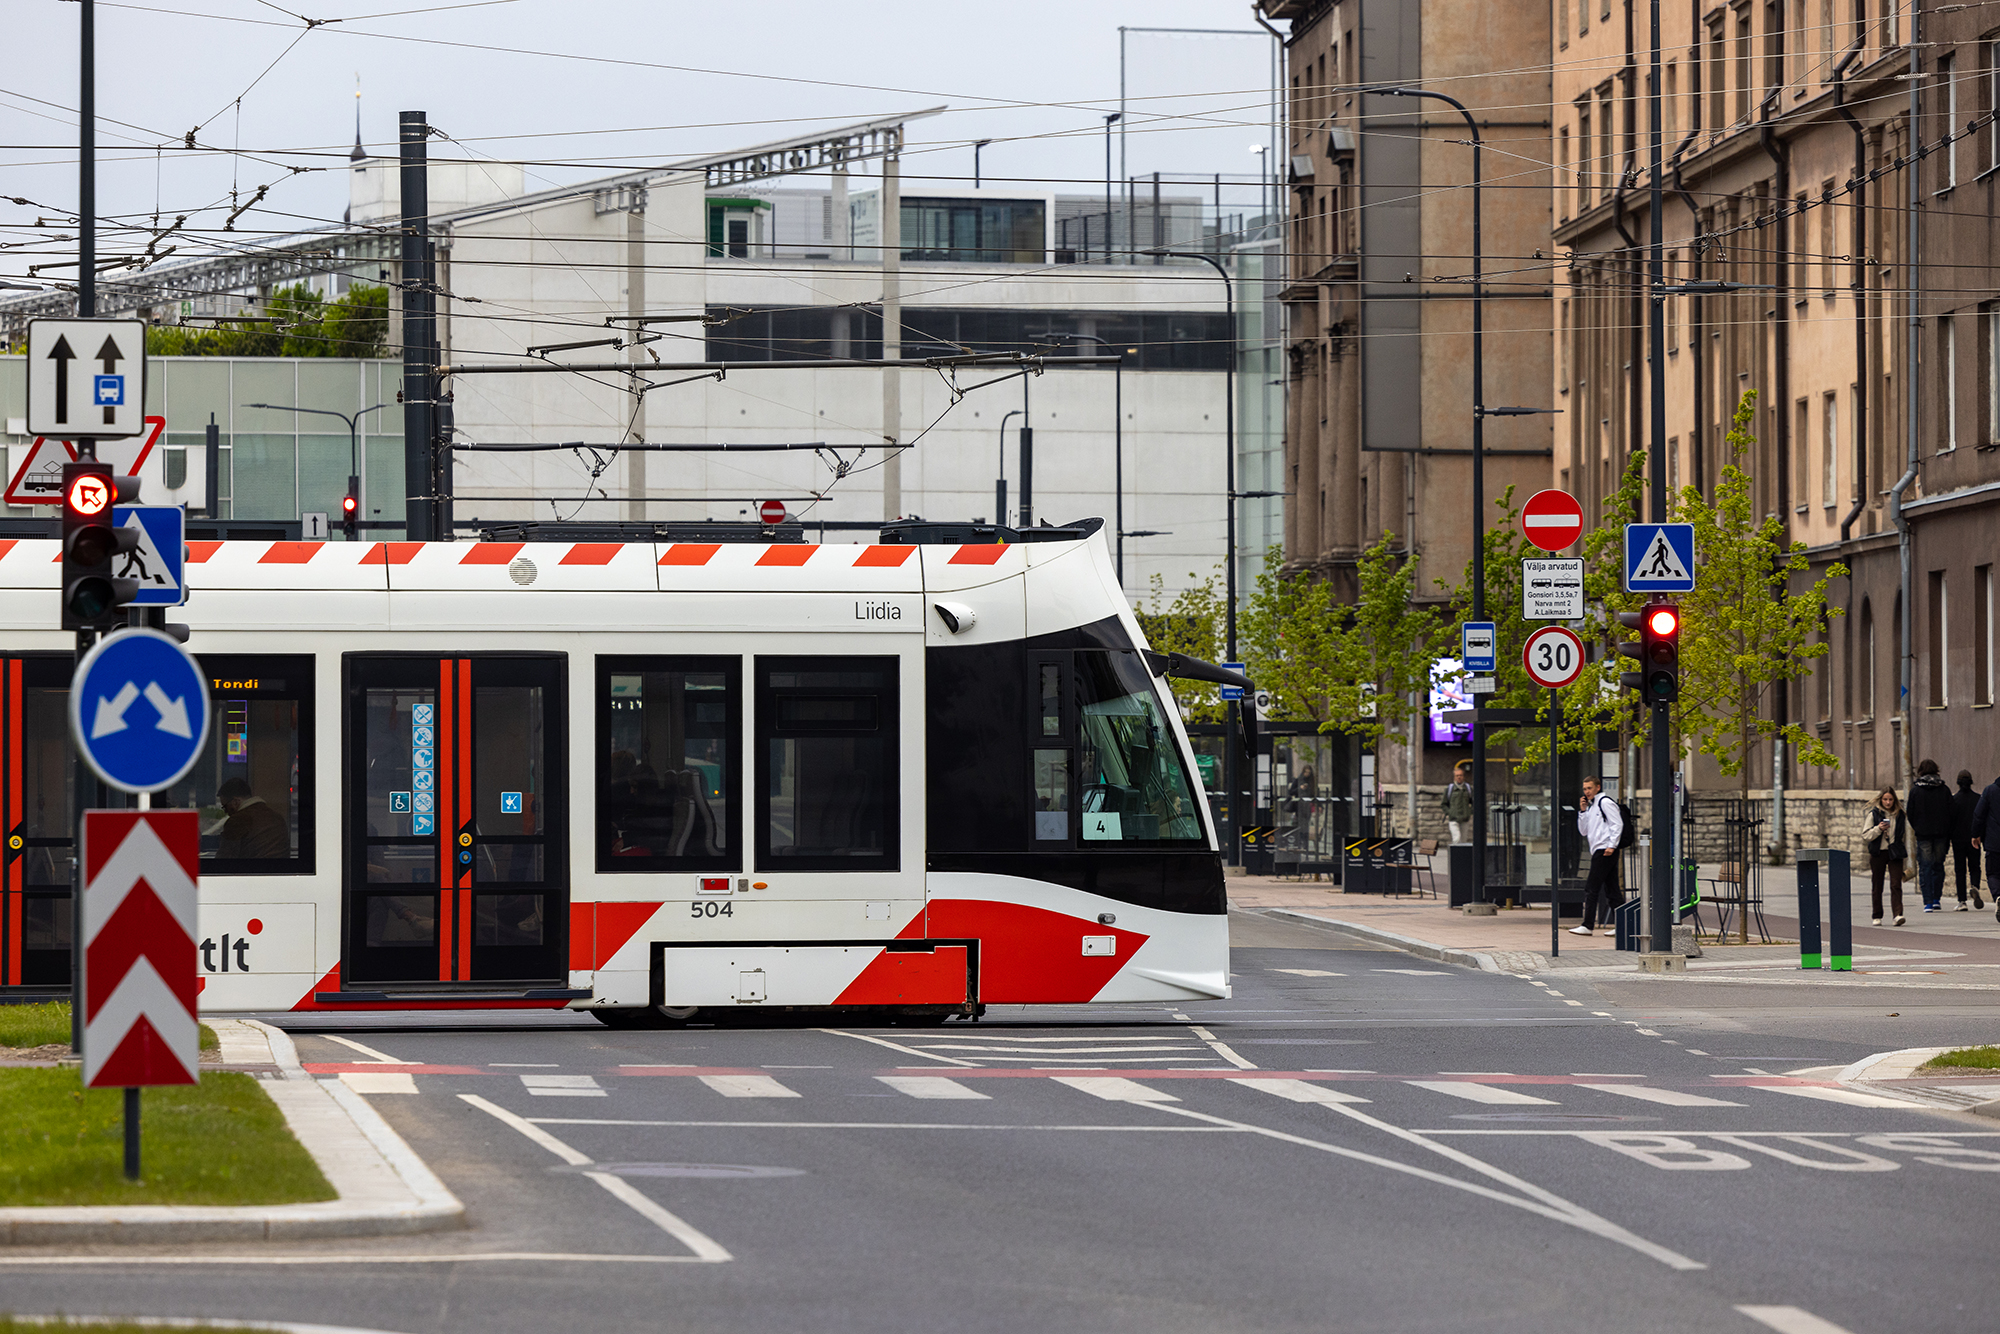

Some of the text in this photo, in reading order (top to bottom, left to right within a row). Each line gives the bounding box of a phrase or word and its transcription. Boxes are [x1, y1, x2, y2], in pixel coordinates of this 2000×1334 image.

[1526, 562, 1578, 573] Välja arvatud
[1555, 591, 1578, 599] 3,5,5a,7
[855, 601, 901, 620] Liidia
[1537, 643, 1571, 671] 30
[213, 679, 259, 689] Tondi
[1096, 820, 1106, 833] 4
[691, 901, 733, 918] 504
[199, 933, 249, 972] tlt
[1581, 1134, 2000, 1172] BUS
